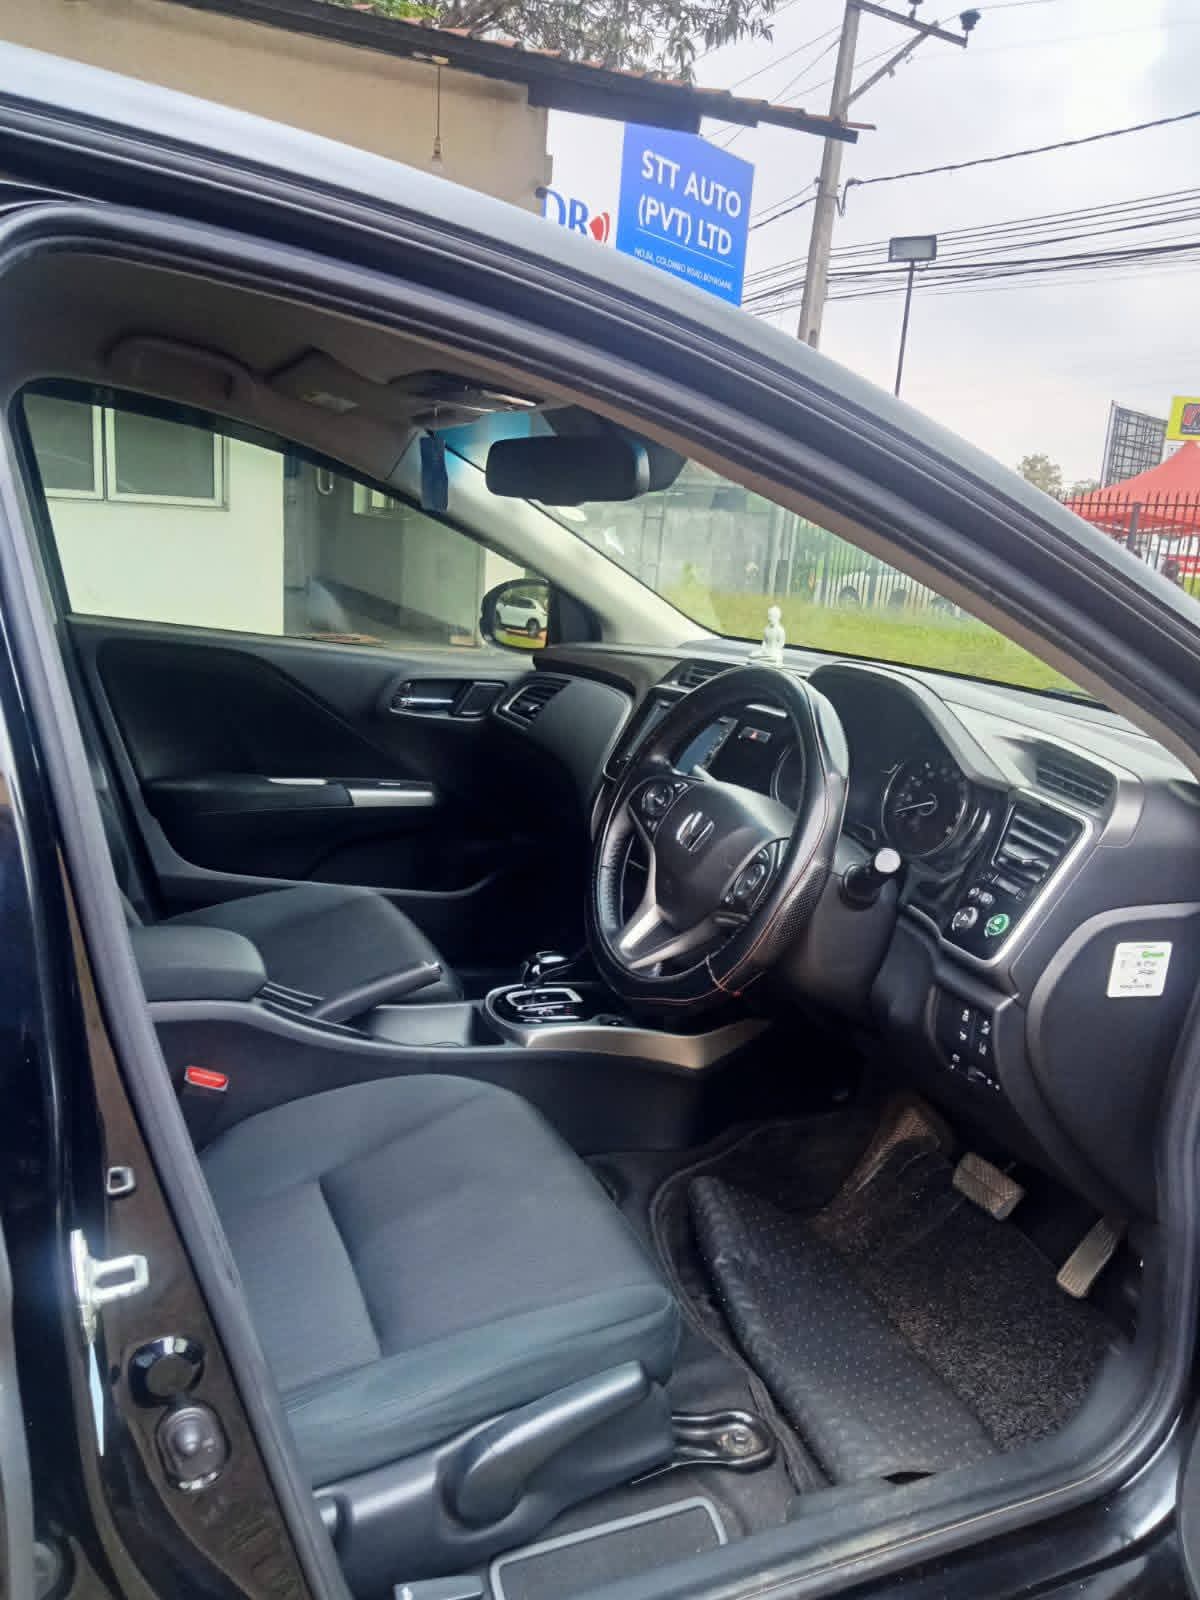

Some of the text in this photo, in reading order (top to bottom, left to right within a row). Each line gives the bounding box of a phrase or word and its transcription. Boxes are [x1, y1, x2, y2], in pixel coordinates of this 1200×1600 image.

[641, 149, 742, 218] STT AUTO
[638, 193, 732, 255] (PVT) LTD
